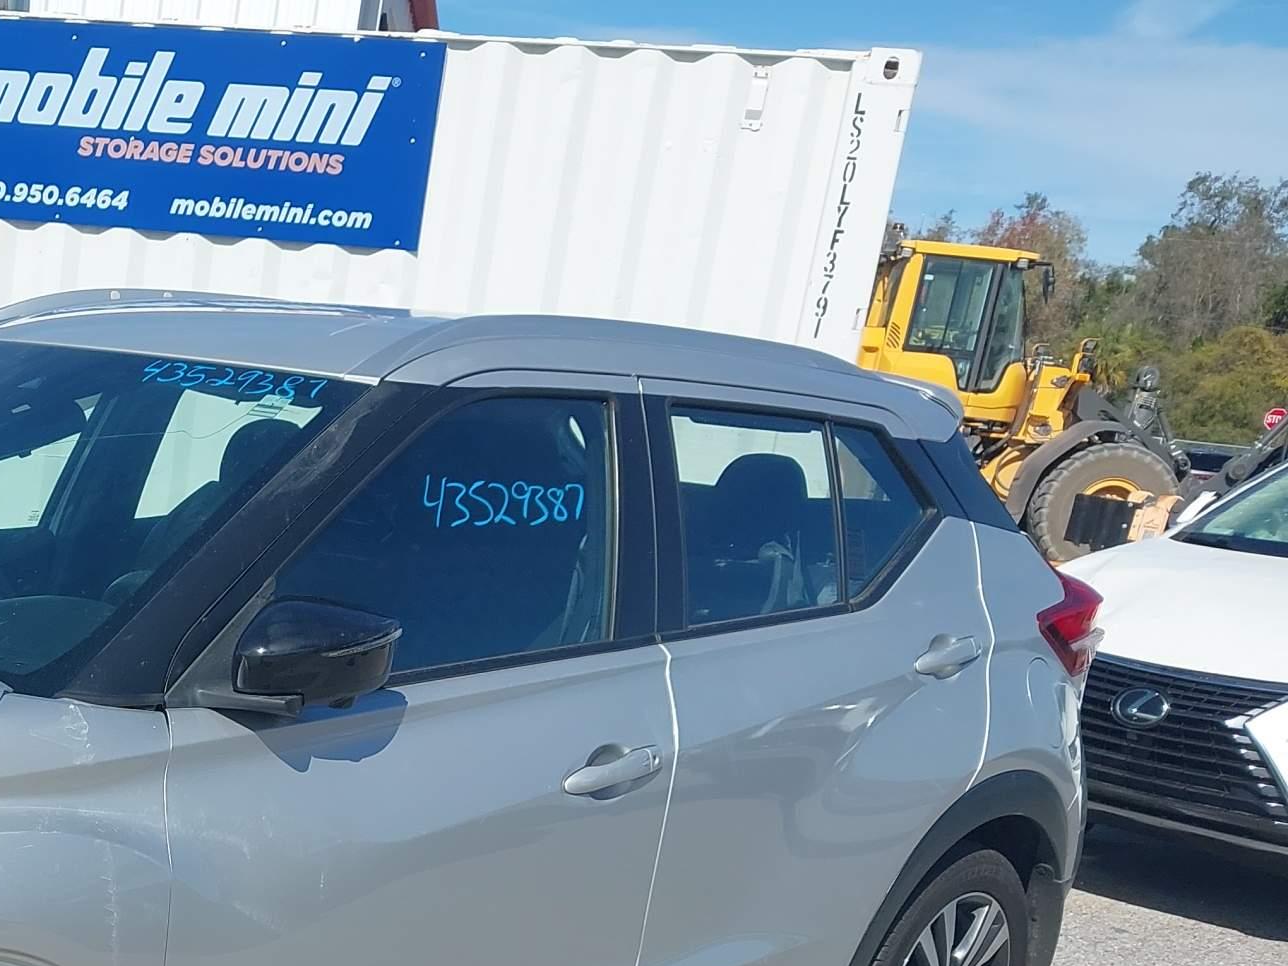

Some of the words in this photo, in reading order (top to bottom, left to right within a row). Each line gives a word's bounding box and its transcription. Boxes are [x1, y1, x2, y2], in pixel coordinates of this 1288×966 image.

[77, 135, 193, 165] STORAGE
[197, 147, 346, 176] SOLUTIONS
[169, 195, 373, 230] mobilemini.com
[141, 359, 329, 400] 43529387
[423, 474, 585, 529] 43529387
